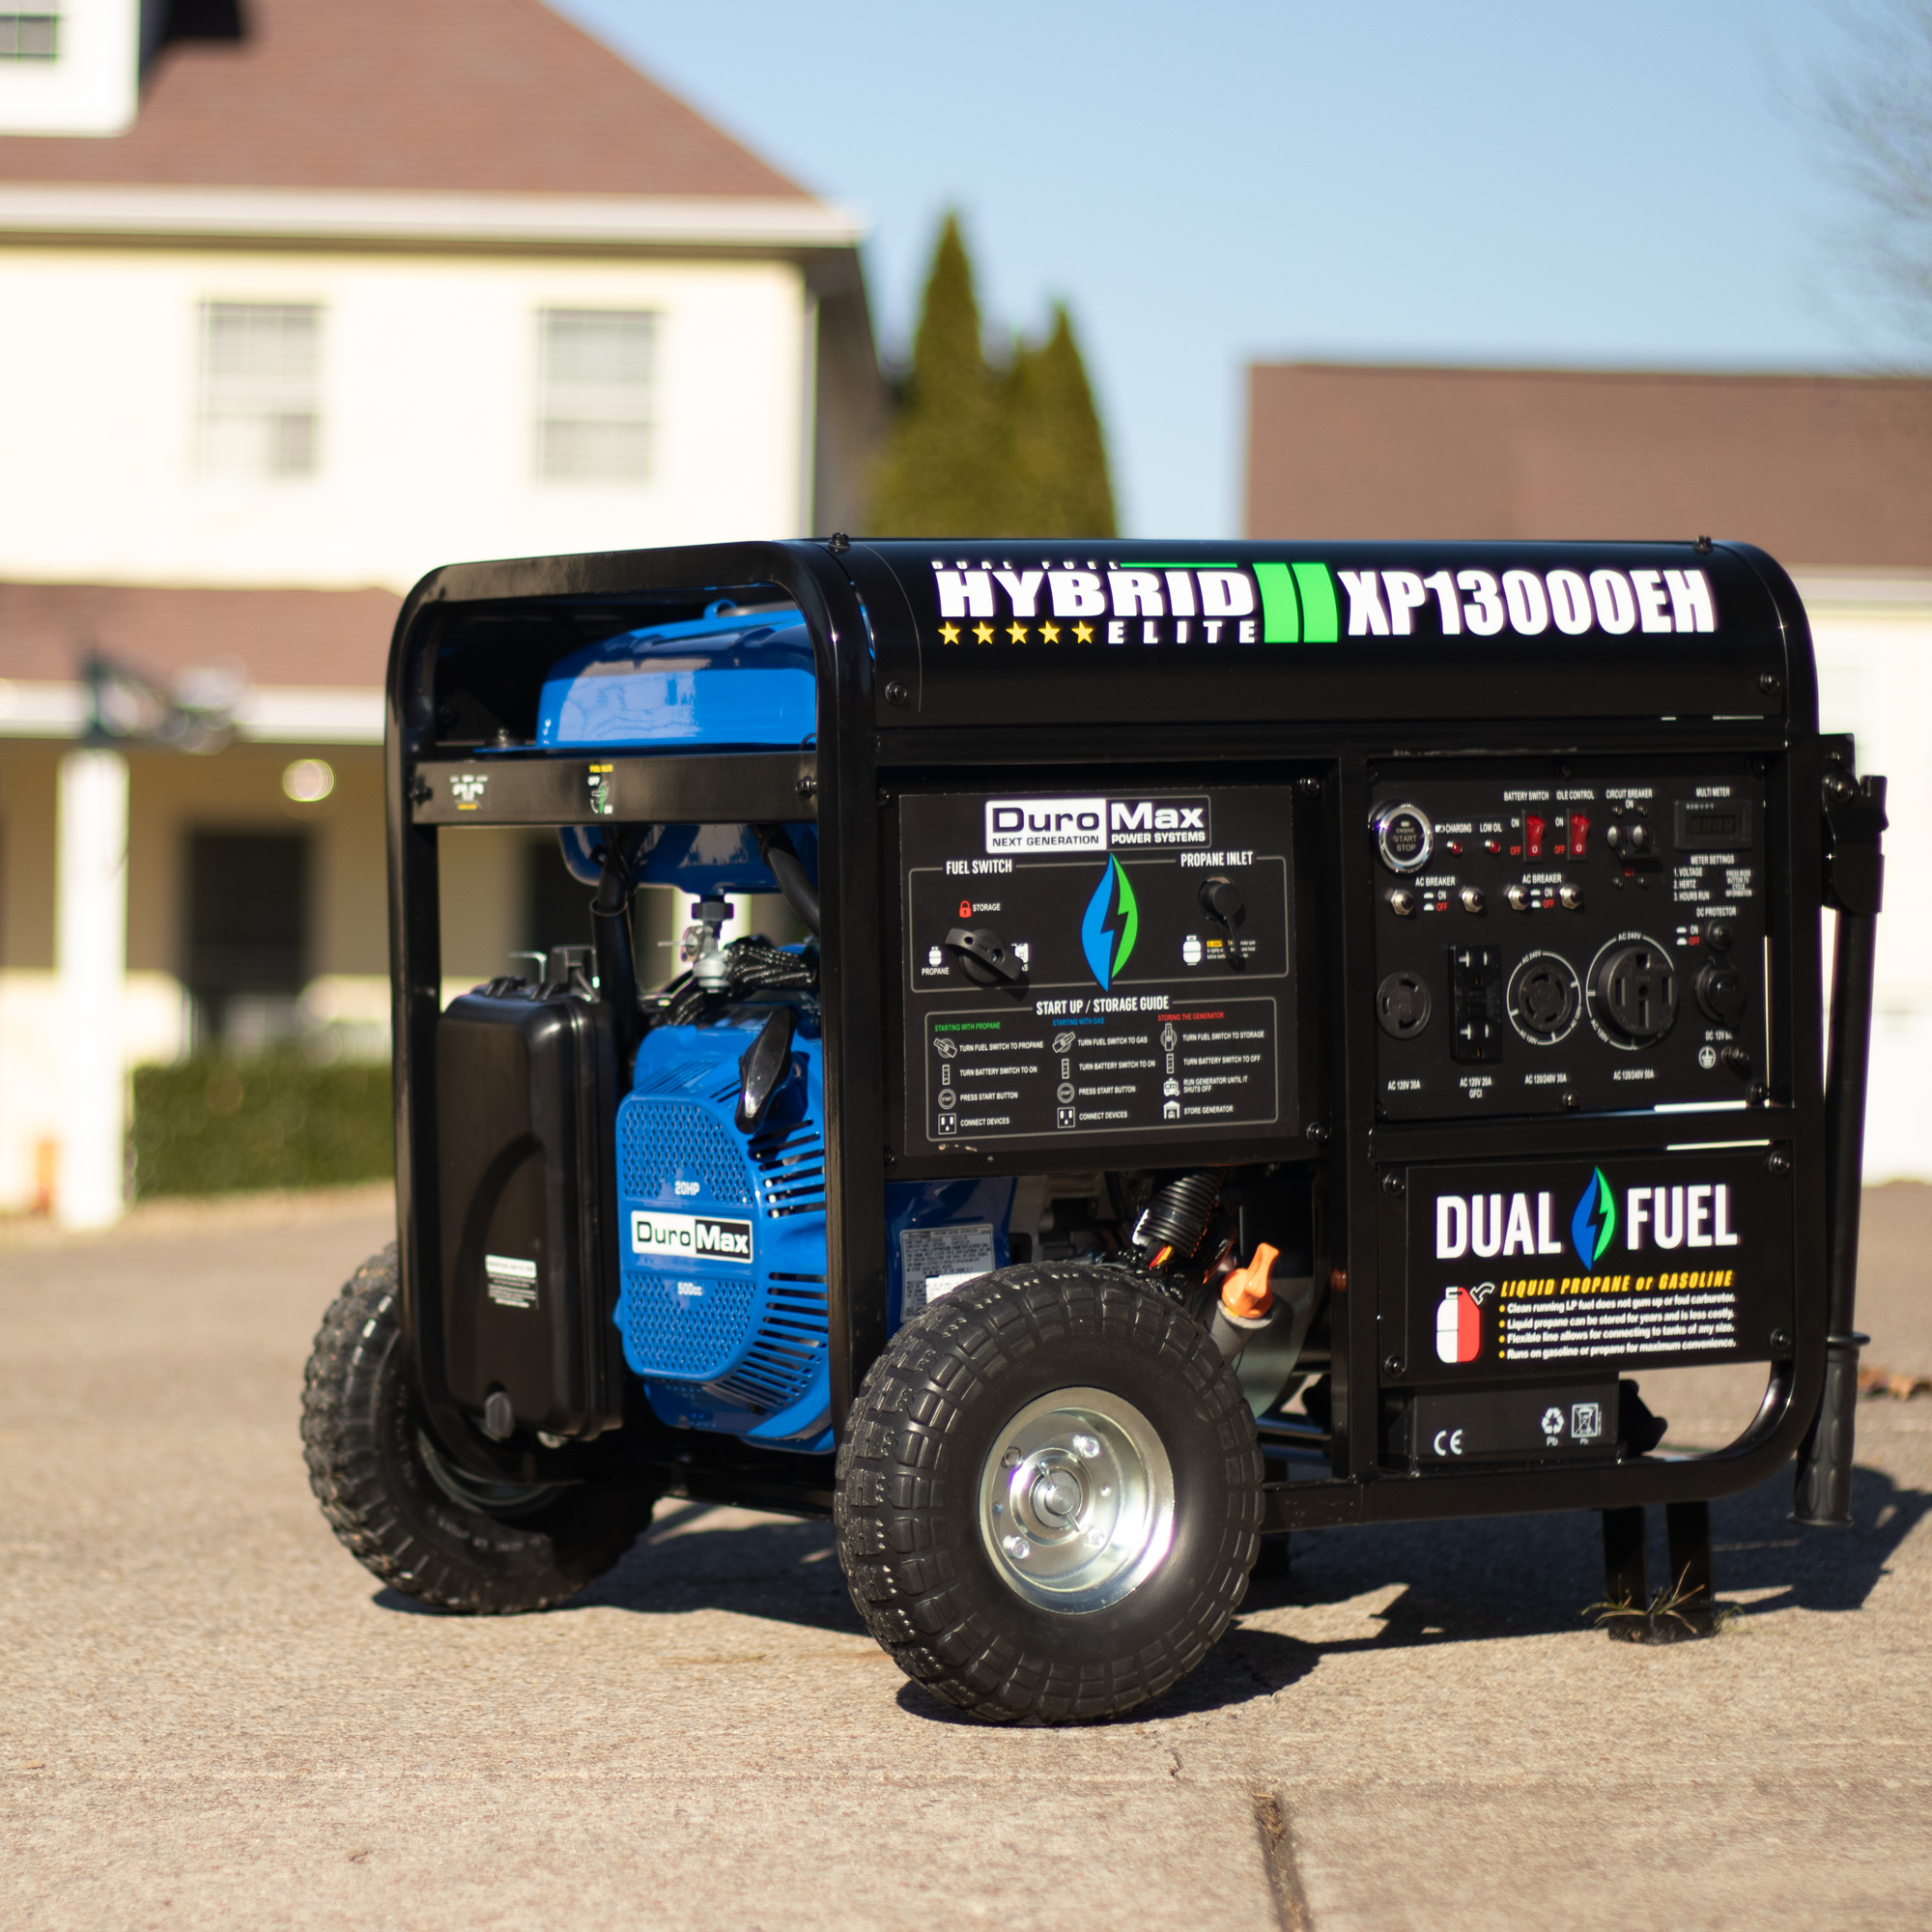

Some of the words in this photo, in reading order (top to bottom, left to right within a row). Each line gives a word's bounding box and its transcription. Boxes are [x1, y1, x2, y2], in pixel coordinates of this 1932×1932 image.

[931, 561, 1012, 570] DUAL
[1041, 561, 1118, 570] FUEL
[935, 571, 1255, 617] HYBRID
[1337, 569, 1715, 637] XP13000EH
[1107, 620, 1256, 644] ELITE
[1503, 790, 1528, 802] BATTERY
[1528, 790, 1549, 801] SWITCH
[1556, 789, 1569, 801] IDLE
[1569, 789, 1594, 801] CONTROL
[1605, 788, 1627, 800] CIRCUIT
[1627, 787, 1653, 799] BREAKER
[1625, 799, 1634, 810] ON
[1480, 822, 1492, 833] LOW
[1492, 821, 1502, 833] OIL
[1511, 817, 1520, 828] ON
[1554, 816, 1564, 827] ON
[1445, 822, 1472, 834] CHARGING
[992, 838, 1022, 847] NEXT
[1026, 836, 1099, 846] GENERATION
[1111, 833, 1151, 844] POWER
[1153, 831, 1206, 843] SYSTEMS
[1393, 835, 1417, 843] START
[1510, 846, 1521, 856] OFF
[1554, 845, 1565, 855] OFF
[1180, 851, 1224, 867] PROPANE
[1227, 850, 1253, 866] INLET
[946, 861, 970, 875] FUEL
[972, 859, 1012, 874] SWITCH
[1415, 876, 1425, 887] AC
[1425, 875, 1456, 887] BREAKER
[1522, 873, 1531, 885] AC
[1532, 872, 1562, 884] BREAKER
[1437, 890, 1447, 900] ON
[1545, 887, 1552, 897] ON
[972, 902, 1001, 912] STORAGE
[1436, 902, 1448, 911] OFF
[1544, 899, 1554, 908] OFF
[1705, 905, 1736, 918] PROTECTOR
[1690, 923, 1698, 935] ON
[1690, 936, 1700, 946] OFF
[922, 967, 950, 976] PROPANE
[1036, 1000, 1067, 1015] START
[1069, 999, 1083, 1013] UP
[1093, 997, 1138, 1013] STORAGE
[1140, 995, 1169, 1010] GUIDE
[1192, 1011, 1224, 1020] GENERATOR
[976, 1021, 1001, 1030] PROPANE
[1052, 1018, 1078, 1027] STARTING
[1079, 1017, 1093, 1026] WITH
[1107, 1037, 1127, 1045] SWITCH
[1211, 1032, 1232, 1040] SWITCH
[1240, 1030, 1264, 1038] STORAGE
[959, 1043, 974, 1052] TURN
[975, 1043, 988, 1052] FUEL
[989, 1042, 1009, 1051] SWITCH
[1010, 1041, 1018, 1050] TO
[1018, 1040, 1043, 1049] PROPANE
[1198, 1057, 1221, 1065] BATTERY
[976, 1067, 999, 1076] BATTERY
[1000, 1066, 1020, 1075] SWITCH
[1114, 1085, 1136, 1094] BUTTON
[1469, 1088, 1483, 1099] GFCI
[1202, 1105, 1234, 1114] GENERATOR
[986, 1117, 1009, 1125] DEVICES
[674, 1180, 700, 1196] 20HP
[1435, 1191, 1561, 1260] DUAL
[1628, 1183, 1738, 1251] FUEL
[677, 1282, 702, 1296] 500cc
[1500, 1278, 1555, 1298] LIQUID
[1560, 1275, 1631, 1294] PROPANE
[1635, 1276, 1653, 1292] or
[1659, 1269, 1733, 1290] GASOLINE
[1507, 1302, 1532, 1314] Clean
[1533, 1300, 1565, 1314] running
[1566, 1299, 1577, 1312] LP
[1577, 1298, 1595, 1310] fuel
[1595, 1297, 1616, 1309] does
[1616, 1296, 1632, 1308] not
[1632, 1297, 1651, 1310] gum
[1652, 1296, 1662, 1309] up
[1663, 1296, 1673, 1306] or
[1674, 1293, 1690, 1306] foul
[1507, 1317, 1533, 1331] Liquid
[1534, 1317, 1569, 1330] propane
[1569, 1317, 1585, 1326] can
[1586, 1314, 1598, 1325] be
[1599, 1312, 1626, 1325] stored
[1627, 1312, 1639, 1323] for
[1639, 1312, 1662, 1325] years
[1663, 1309, 1680, 1321] and
[1681, 1309, 1689, 1321] is
[1689, 1308, 1707, 1321] less
[1507, 1331, 1541, 1344] Flexible
[1542, 1330, 1559, 1343] line
[1560, 1329, 1588, 1342] allows
[1589, 1327, 1603, 1340] for
[1603, 1325, 1651, 1340] connecting
[1652, 1325, 1662, 1337] to
[1662, 1323, 1687, 1336] tanks
[1687, 1322, 1697, 1334] of
[1697, 1323, 1714, 1336] any
[1507, 1348, 1529, 1359] Runs
[1530, 1349, 1542, 1359] on
[1543, 1345, 1578, 1360] gasoline
[1579, 1346, 1589, 1356] or
[1590, 1344, 1625, 1357] propane
[1626, 1341, 1638, 1352] for
[1639, 1340, 1681, 1352] maximum
[1434, 1429, 1463, 1457] CE
[1547, 1435, 1558, 1447] Pb
